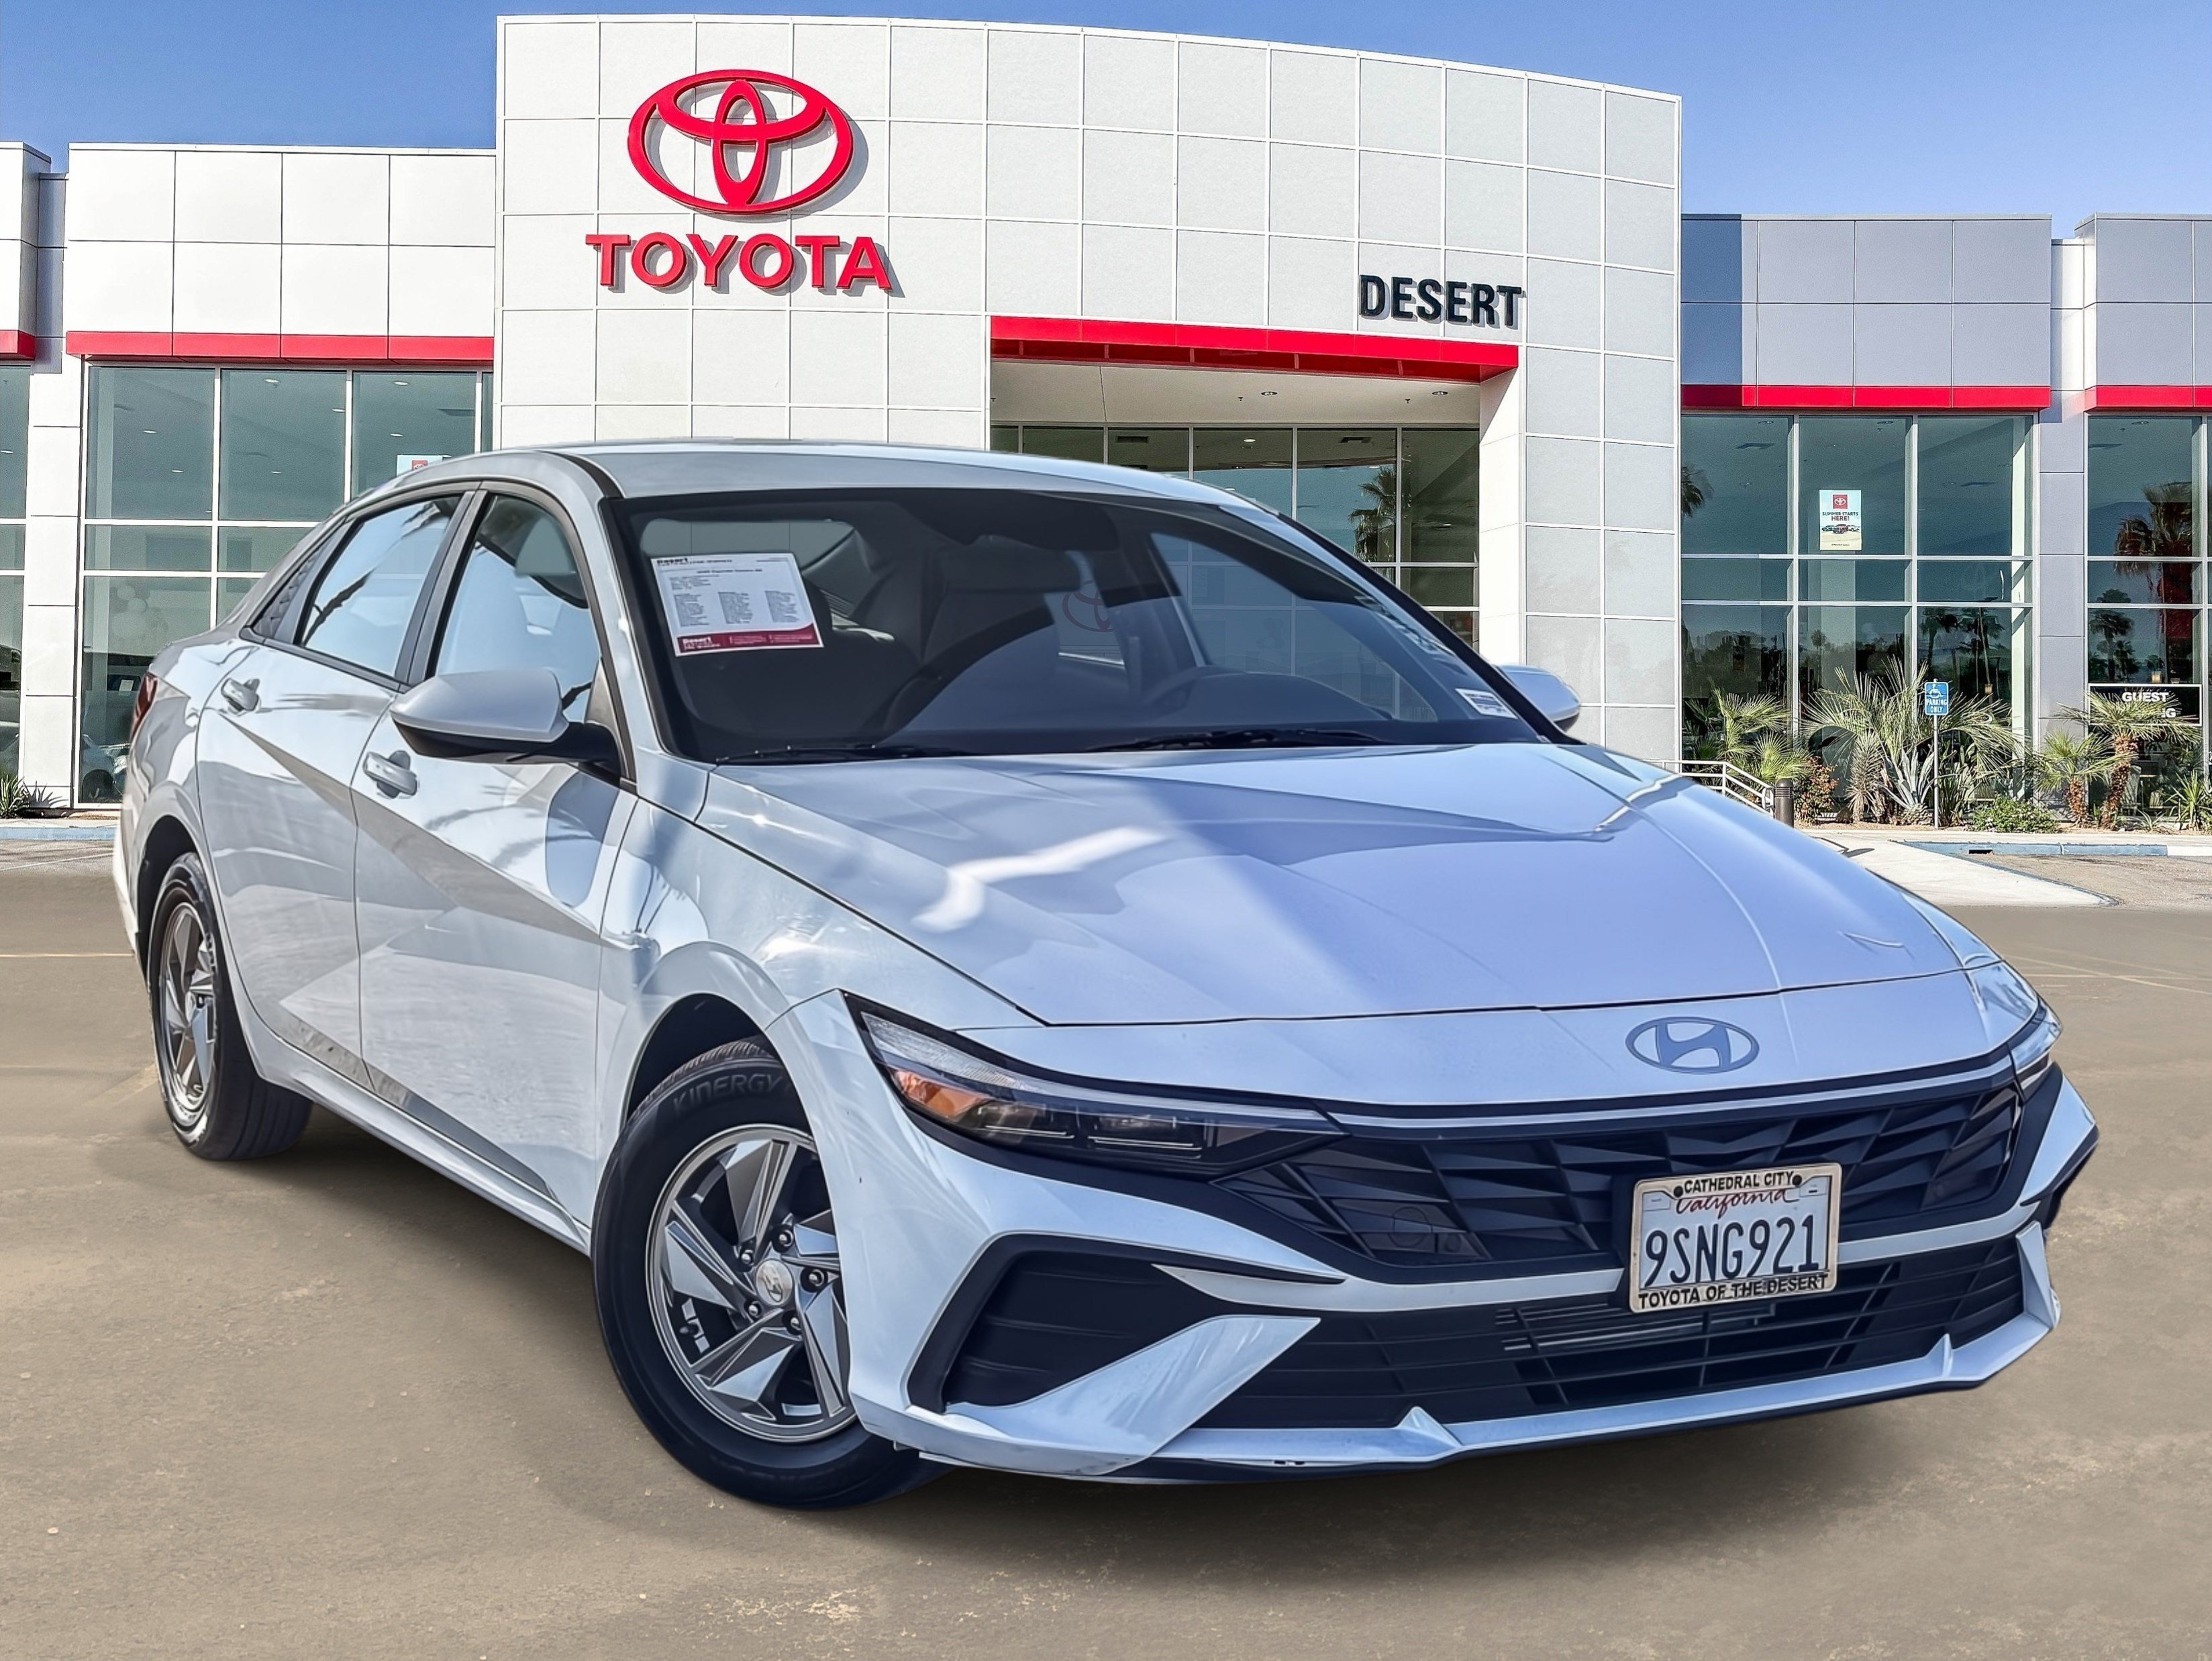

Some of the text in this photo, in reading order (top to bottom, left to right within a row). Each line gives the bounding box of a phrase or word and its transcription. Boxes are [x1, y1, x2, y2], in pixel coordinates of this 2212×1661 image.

[585, 232, 892, 290] TOYOTA
[1358, 274, 1522, 326] DESERT
[2121, 692, 2170, 703] GUEST
[1684, 1171, 1794, 1195] CATHEDRAL CITY
[1676, 1189, 1799, 1219] California
[1644, 1214, 1819, 1287] 9SNG921
[1639, 1274, 1829, 1309] TOYOTA OF THE DESERT
